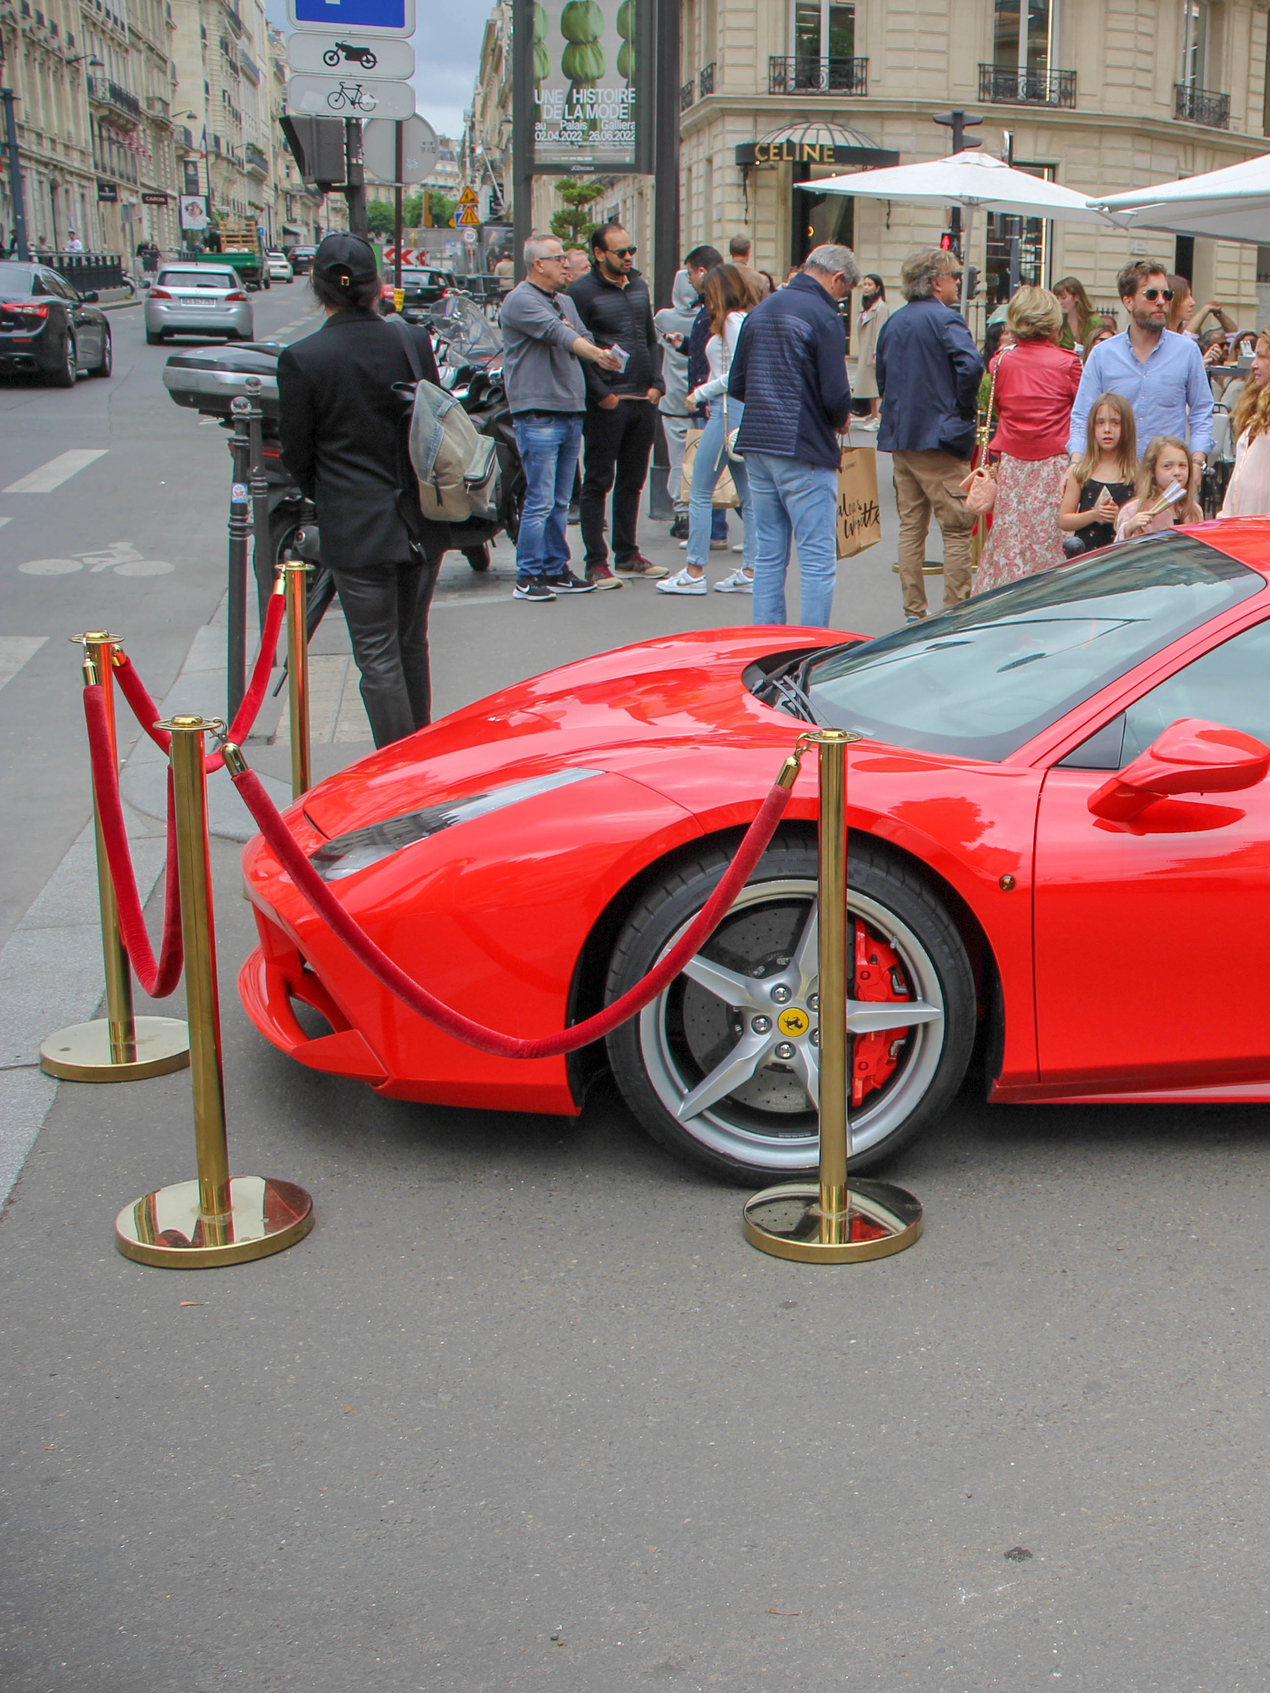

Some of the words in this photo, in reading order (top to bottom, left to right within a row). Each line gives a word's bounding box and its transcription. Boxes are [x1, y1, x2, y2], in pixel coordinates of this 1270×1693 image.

[534, 89, 564, 104] UNE
[572, 88, 636, 104] HISTOIRE
[543, 104, 562, 120] DE
[564, 104, 584, 120] LA
[586, 104, 629, 119] MODE
[534, 121, 547, 131] au
[560, 120, 588, 131] Palais
[601, 120, 636, 131] Galliera
[534, 130, 583, 141] 02.04.2022
[588, 130, 636, 141] 26.06.2022
[755, 143, 836, 162] CELINE
